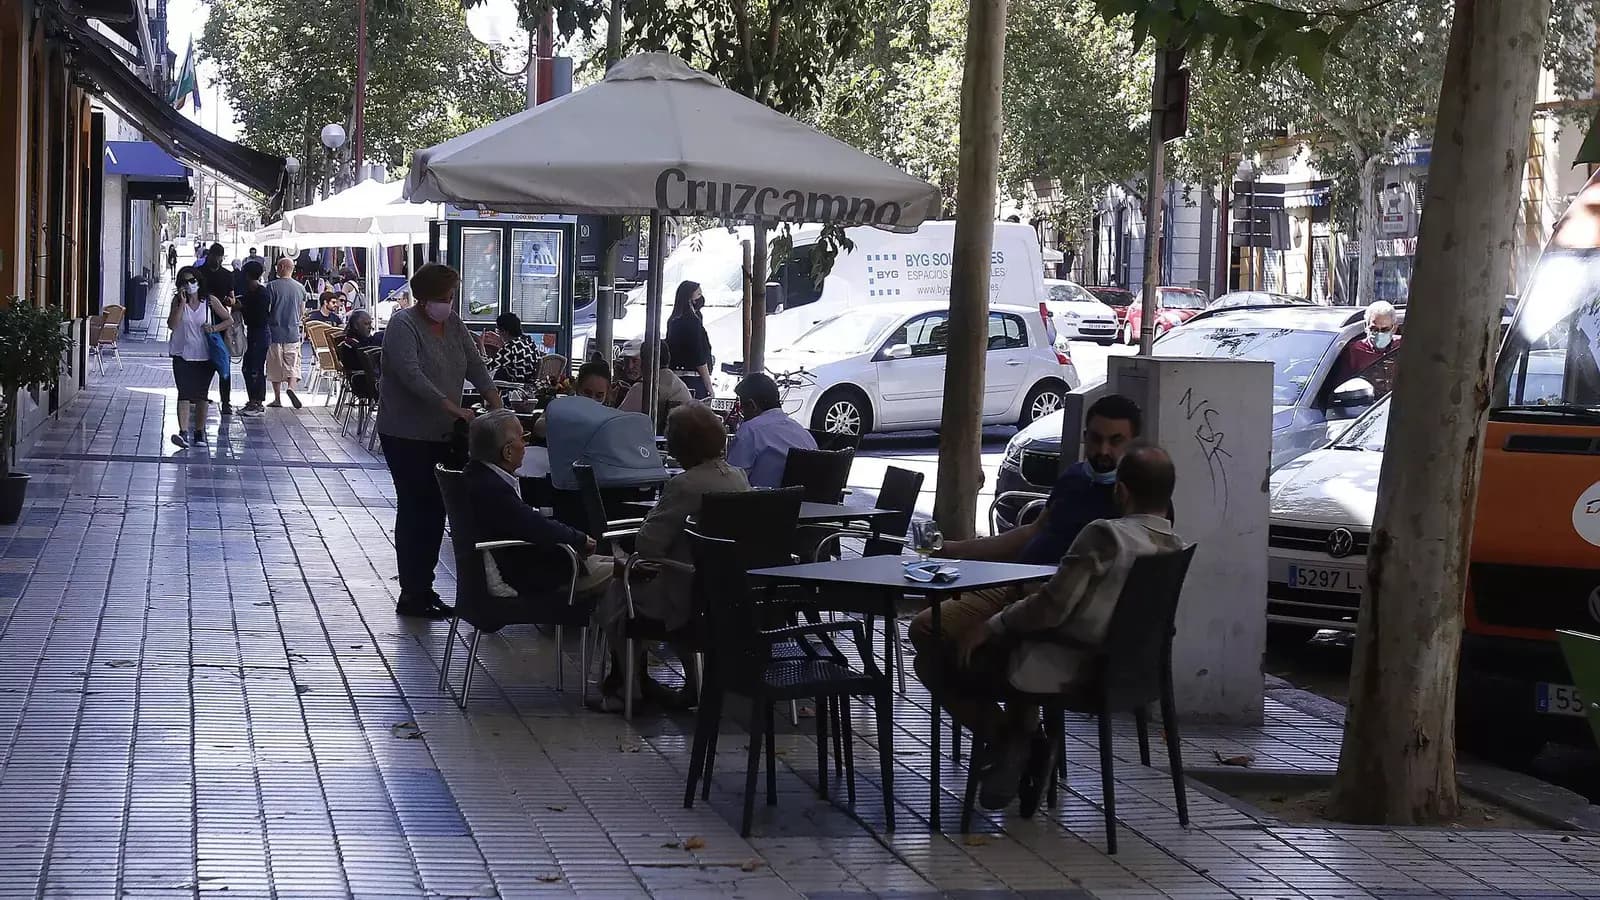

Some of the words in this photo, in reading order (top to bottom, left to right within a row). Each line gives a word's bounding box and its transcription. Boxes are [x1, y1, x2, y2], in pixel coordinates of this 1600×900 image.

[655, 168, 901, 226] Cruzcampo
[905, 253, 930, 267] BYG
[877, 270, 899, 279] BYG
[907, 270, 949, 281] ESPACIOS
[1298, 568, 1340, 588] 5297
